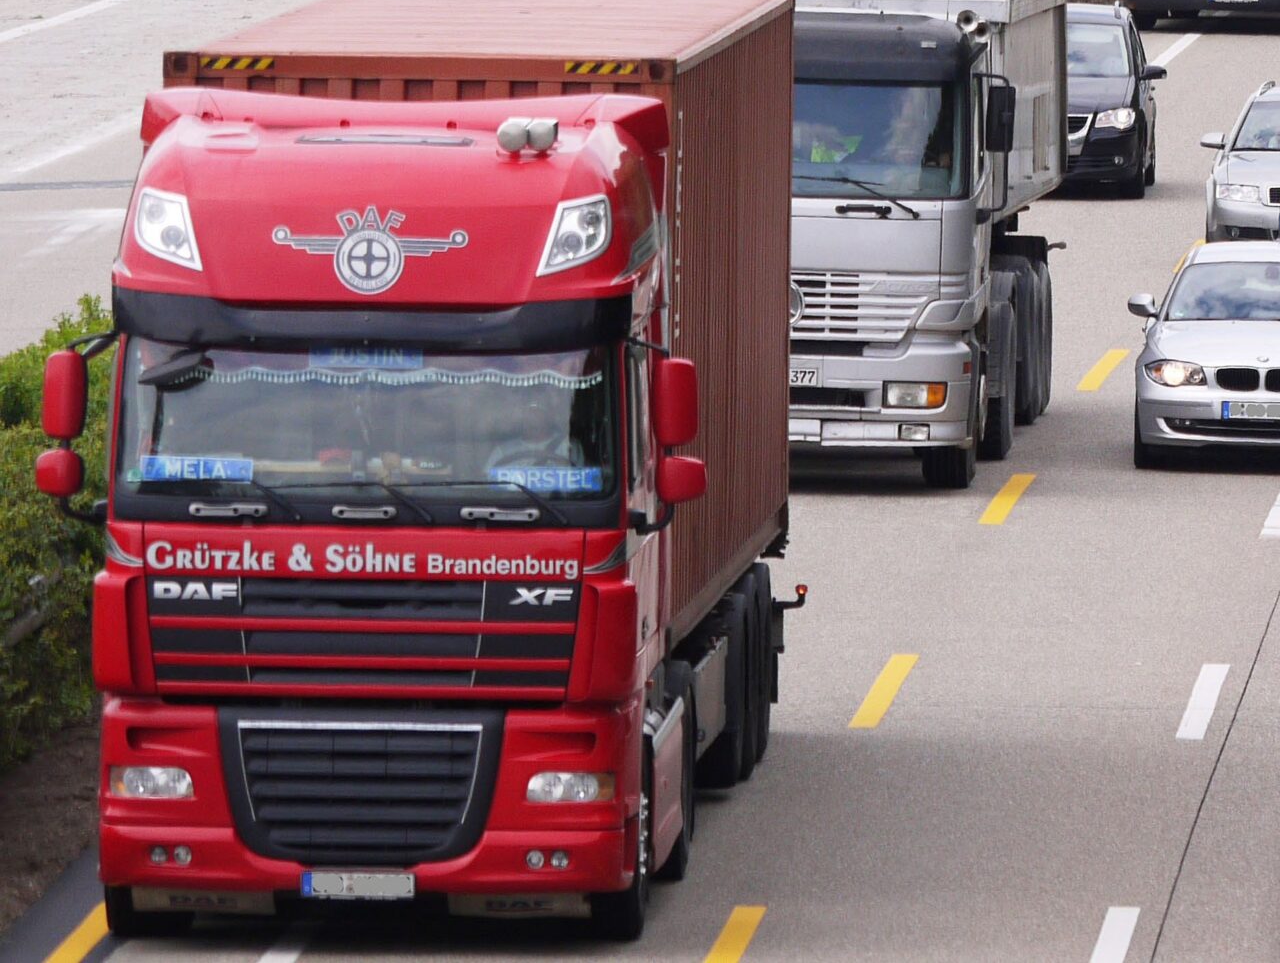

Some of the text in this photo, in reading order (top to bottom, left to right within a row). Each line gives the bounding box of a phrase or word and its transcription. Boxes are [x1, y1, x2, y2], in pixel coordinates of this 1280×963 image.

[336, 205, 406, 236] DAF
[790, 370, 815, 384] 377
[165, 458, 227, 479] MELA
[288, 543, 313, 572] &
[427, 554, 579, 580] Brandenburg
[153, 581, 238, 600] DAF
[509, 588, 574, 605] XF
